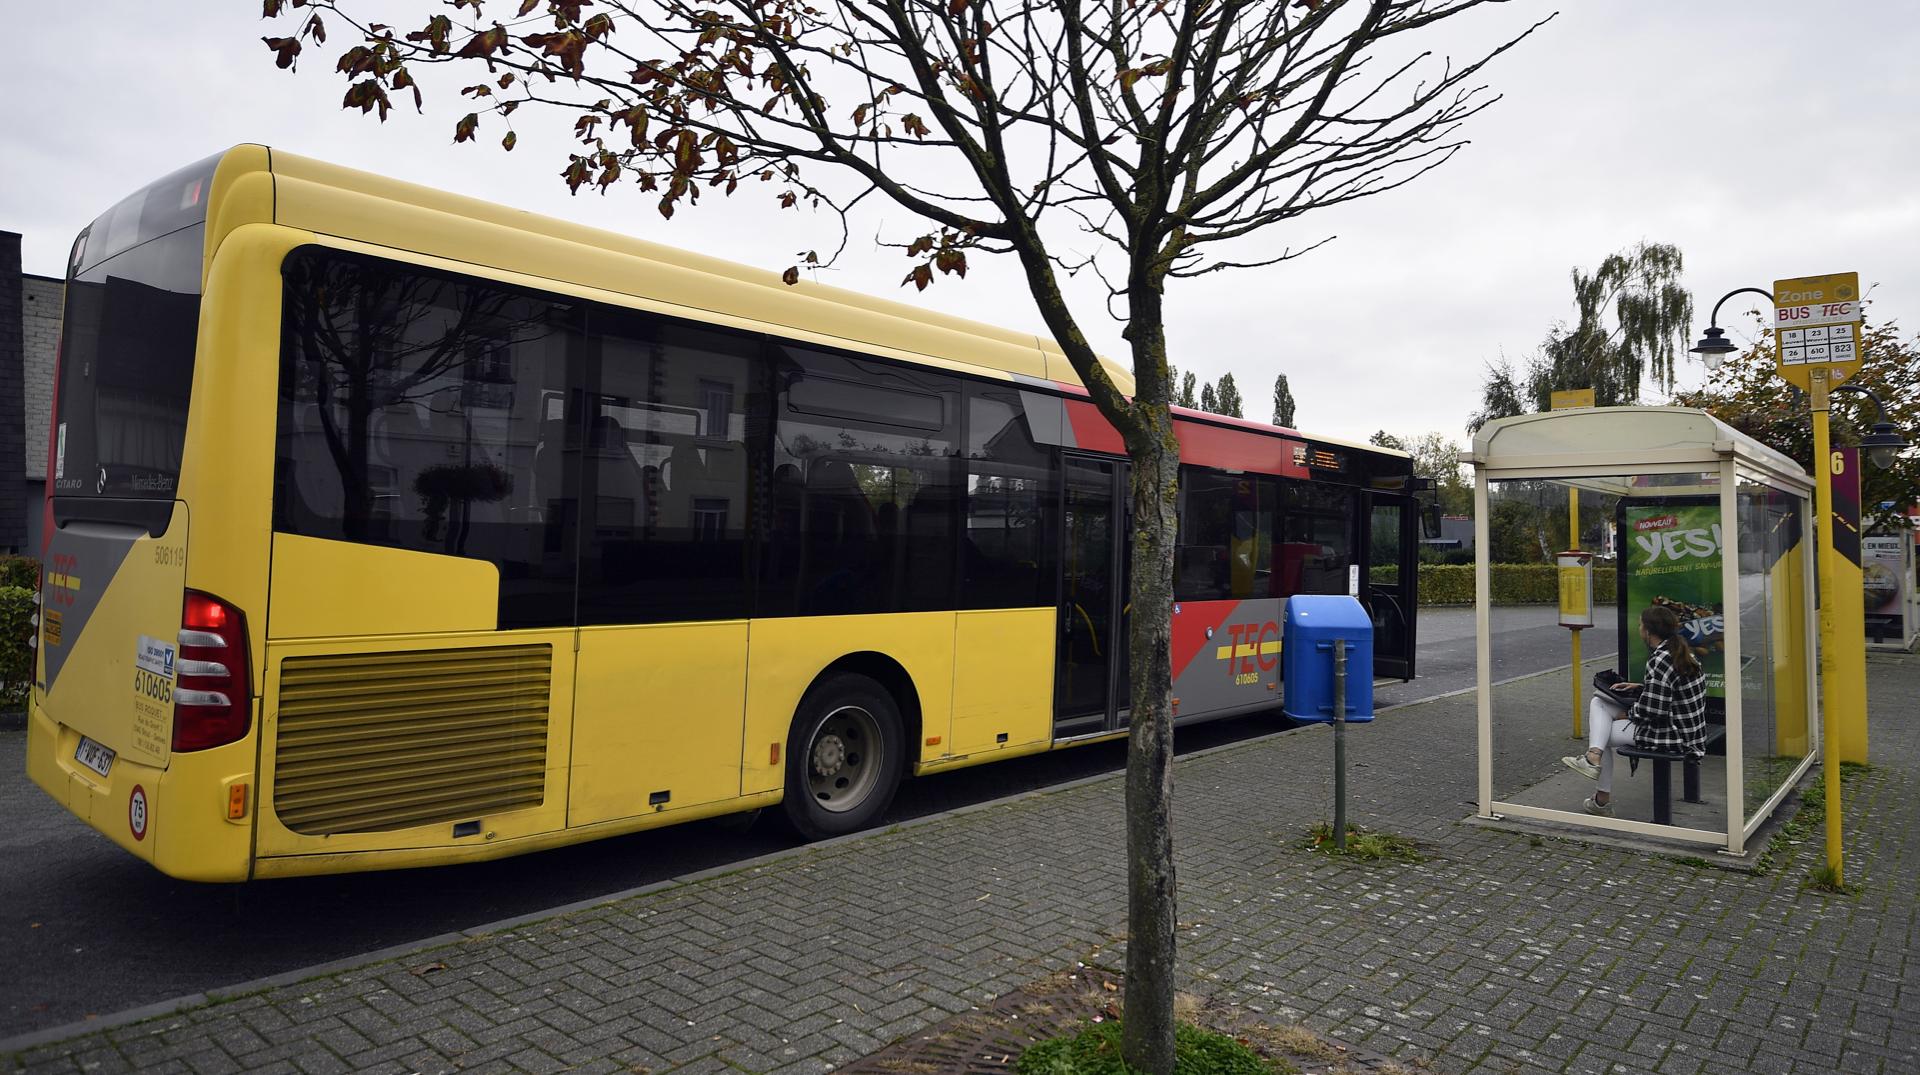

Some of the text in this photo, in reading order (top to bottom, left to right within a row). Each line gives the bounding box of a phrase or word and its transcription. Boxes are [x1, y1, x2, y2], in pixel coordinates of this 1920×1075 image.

[1779, 290, 1823, 303] Zone
[1779, 302, 1851, 320] BUS TEC
[1835, 344, 1851, 353] 823
[1830, 451, 1845, 475] 6
[55, 473, 174, 491] CITARO Mercedes-Benz
[154, 545, 184, 567] 506119
[1227, 620, 1278, 677] TEC
[135, 669, 171, 704] 610605
[1235, 672, 1259, 686] 610605
[133, 798, 144, 819] 75
